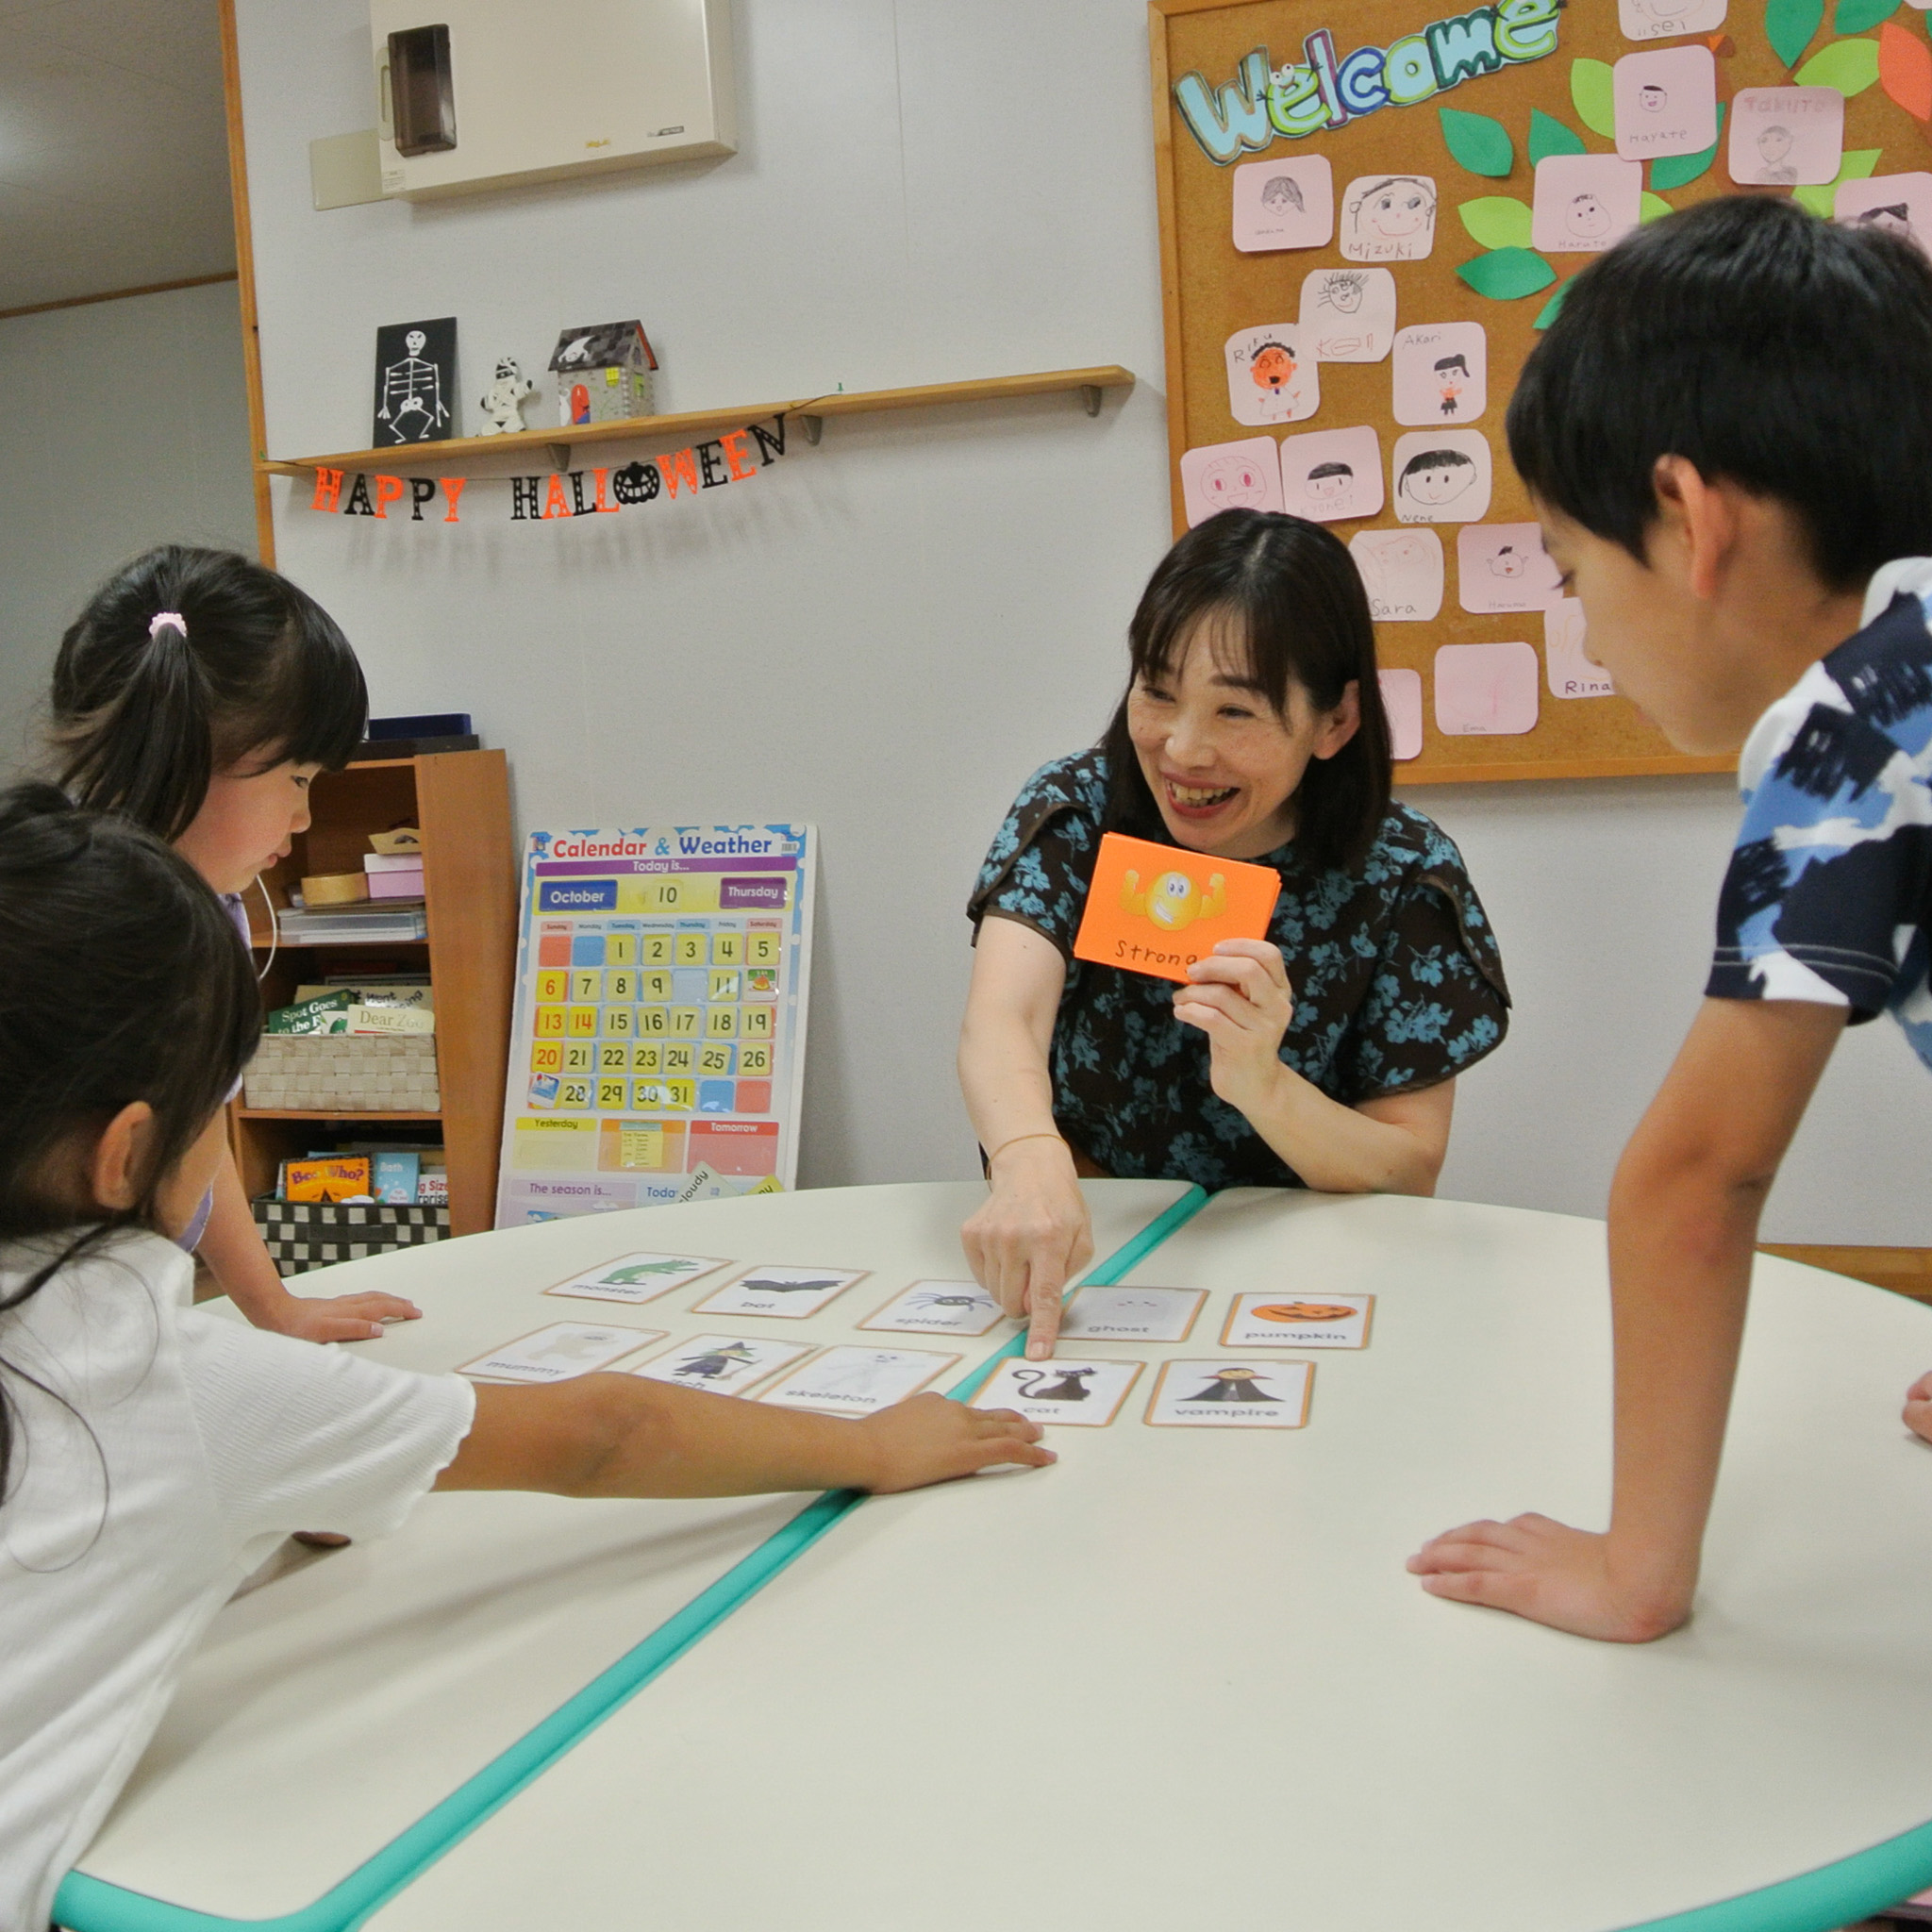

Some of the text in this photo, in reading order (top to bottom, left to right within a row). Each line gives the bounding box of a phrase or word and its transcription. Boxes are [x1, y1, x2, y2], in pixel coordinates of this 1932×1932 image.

[1174, 0, 1561, 167] Welcome
[310, 466, 466, 522] HAPPY
[1372, 598, 1417, 617] Sara
[1565, 680, 1611, 694] Rina
[553, 835, 772, 858] Calendar & Weather
[633, 860, 669, 874] Today
[550, 886, 778, 904] October 10 Thursday
[578, 923, 602, 931] Monday
[718, 921, 737, 929] Friday
[750, 920, 776, 928] Saturday
[618, 941, 769, 958] 1 2 3 4 5
[545, 979, 556, 995] 6
[582, 978, 592, 995] 7
[616, 977, 626, 994] 8
[652, 977, 663, 993] 9
[282, 1007, 308, 1023] Spot
[309, 998, 338, 1015] Goes
[359, 1010, 393, 1025] Dear
[291, 1020, 310, 1034] the
[544, 1013, 766, 1030] 13 14 15 16 17 18 19
[537, 1049, 765, 1069] 20 21 22 23 24 25 26
[565, 1085, 688, 1103] 28 29 30 31
[534, 1119, 578, 1130] Yesterday
[710, 1122, 758, 1133] Tomorrow
[529, 1183, 551, 1194] The
[551, 1185, 591, 1196] season
[647, 1186, 678, 1198] Toda
[571, 1283, 642, 1297] monster
[741, 1301, 774, 1309] bat
[895, 1317, 963, 1326] spider
[1088, 1324, 1150, 1333] ghost
[1244, 1331, 1347, 1341] pumpkin
[485, 1360, 566, 1376] mummy
[670, 1378, 706, 1390] itch
[785, 1390, 877, 1405] skeleton
[1023, 1406, 1061, 1415] cat
[1174, 1407, 1279, 1418] vampire
